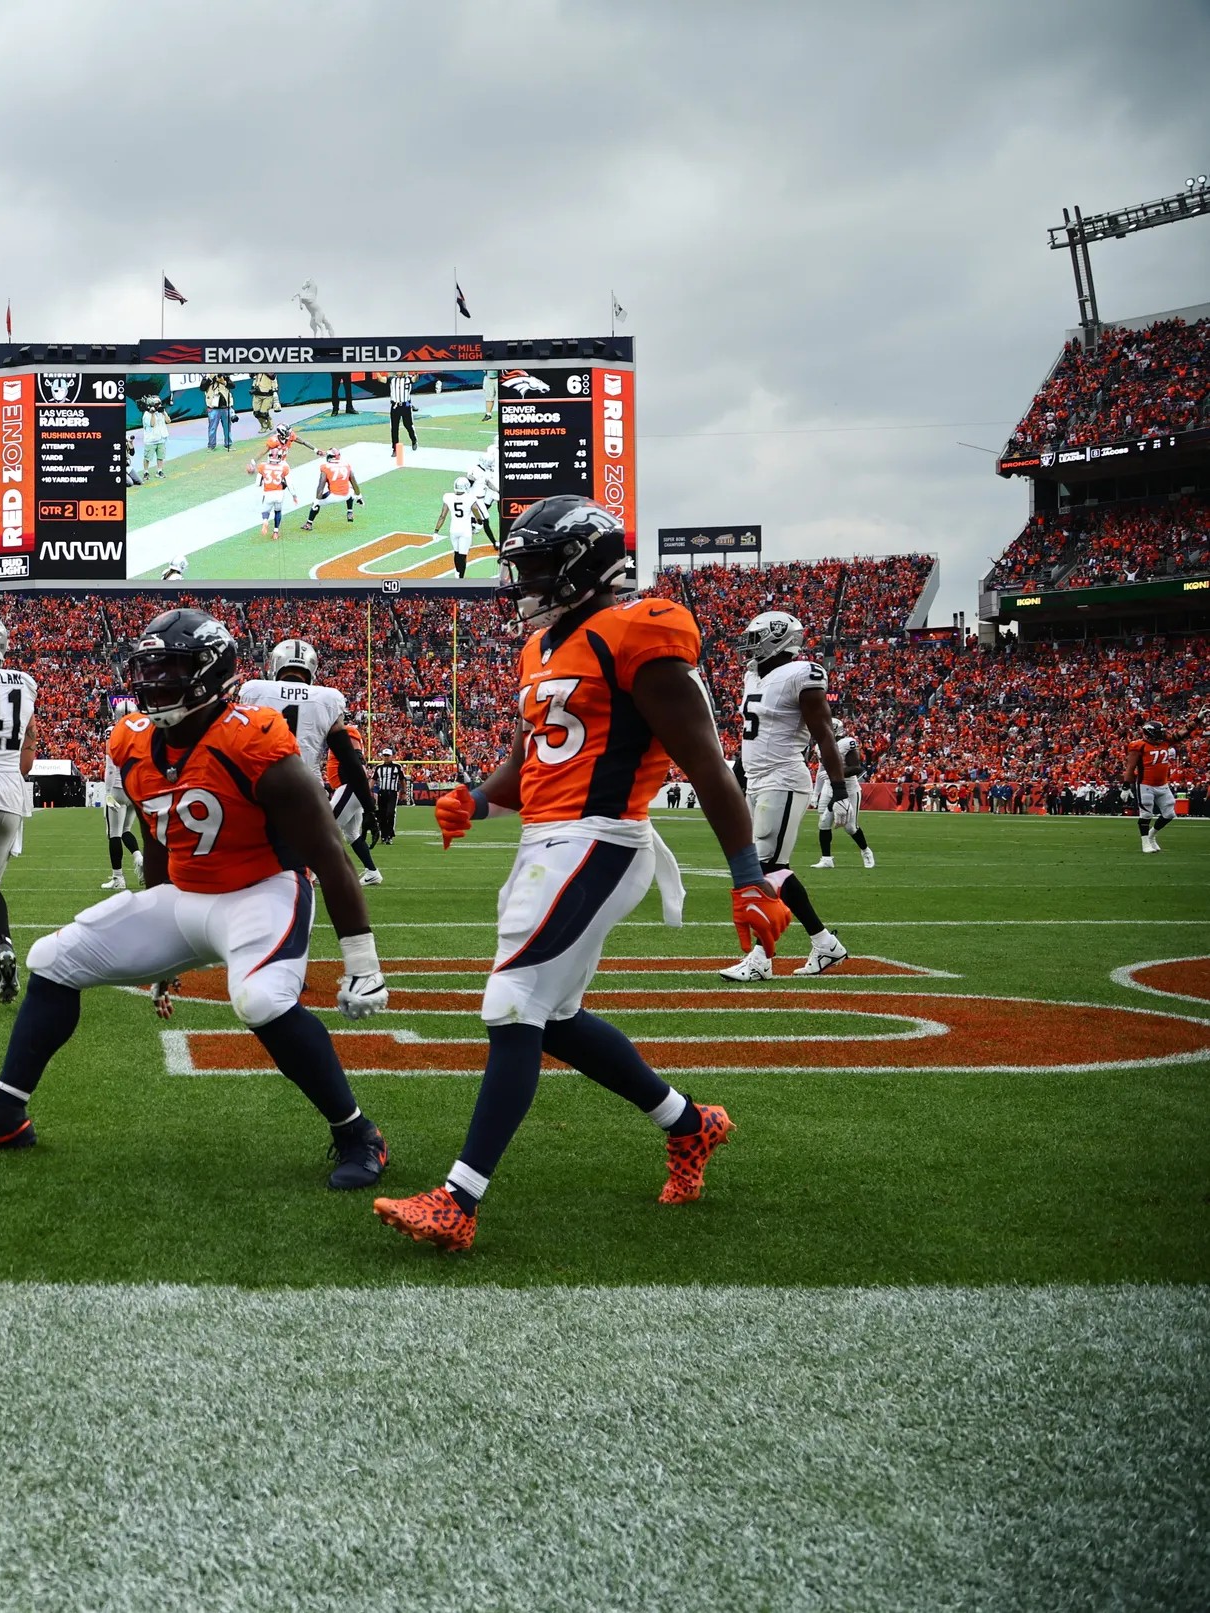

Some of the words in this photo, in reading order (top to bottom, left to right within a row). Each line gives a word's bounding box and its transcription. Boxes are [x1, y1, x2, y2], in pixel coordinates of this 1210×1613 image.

[204, 346, 314, 363] EMPOWER
[342, 345, 402, 362] FIELD
[458, 344, 481, 353] MILE
[458, 352, 482, 360] HIGH
[92, 380, 118, 400] 10
[566, 375, 582, 394] 6
[39, 409, 55, 417] LAS
[56, 409, 84, 417] VEGAS
[501, 405, 536, 414] DENVER
[39, 417, 90, 427] RAIDERS
[501, 413, 561, 423] BRONCOS
[504, 428, 540, 436] RUSHING
[540, 427, 566, 435] STATS
[603, 399, 623, 459] RED
[2, 404, 23, 484] ZONE
[504, 439, 539, 447] ATTEMPTS
[112, 454, 121, 462] 31
[575, 450, 586, 458] 43
[1058, 454, 1085, 463] LEADER
[1001, 459, 1040, 469] BRONCOS
[115, 476, 122, 484] 0
[263, 469, 283, 485] 33
[330, 467, 348, 481] 79
[604, 464, 625, 526] ZON
[40, 505, 62, 515] QTR
[64, 504, 74, 517] 2
[85, 504, 118, 517] 0:12
[454, 502, 464, 518] 5
[509, 502, 532, 515] 2N
[2, 488, 23, 548] RED
[740, 535, 756, 544] 50
[39, 541, 123, 561] ARROW
[1, 558, 23, 568] BUD
[384, 581, 398, 592] 40
[809, 663, 824, 681] 5
[280, 686, 309, 700] EPPS
[743, 694, 763, 741] 5
[1149, 749, 1169, 766] 72
[142, 788, 224, 857] 79
